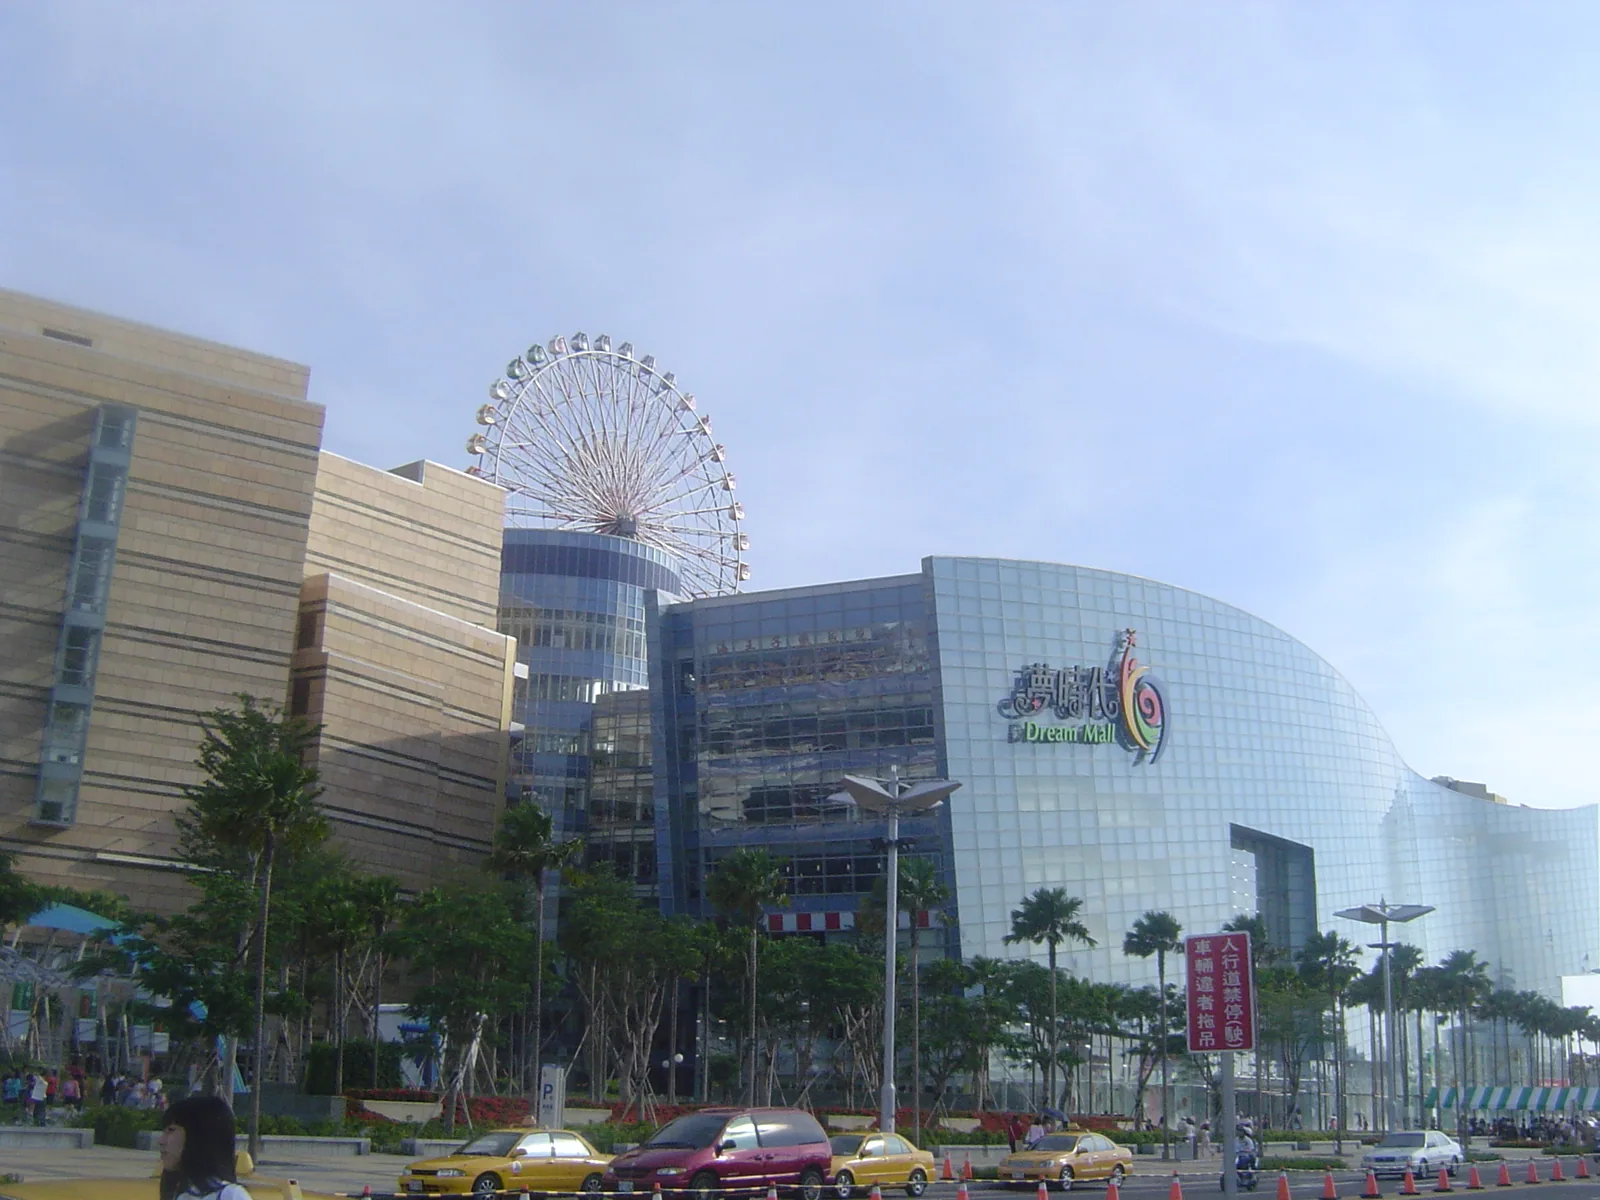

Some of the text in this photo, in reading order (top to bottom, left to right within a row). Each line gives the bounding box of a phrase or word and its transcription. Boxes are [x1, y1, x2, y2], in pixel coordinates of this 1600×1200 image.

[1013, 662, 1118, 719] 夢時代
[1024, 722, 1116, 744] Dream Mall
[543, 1083, 553, 1100] P
